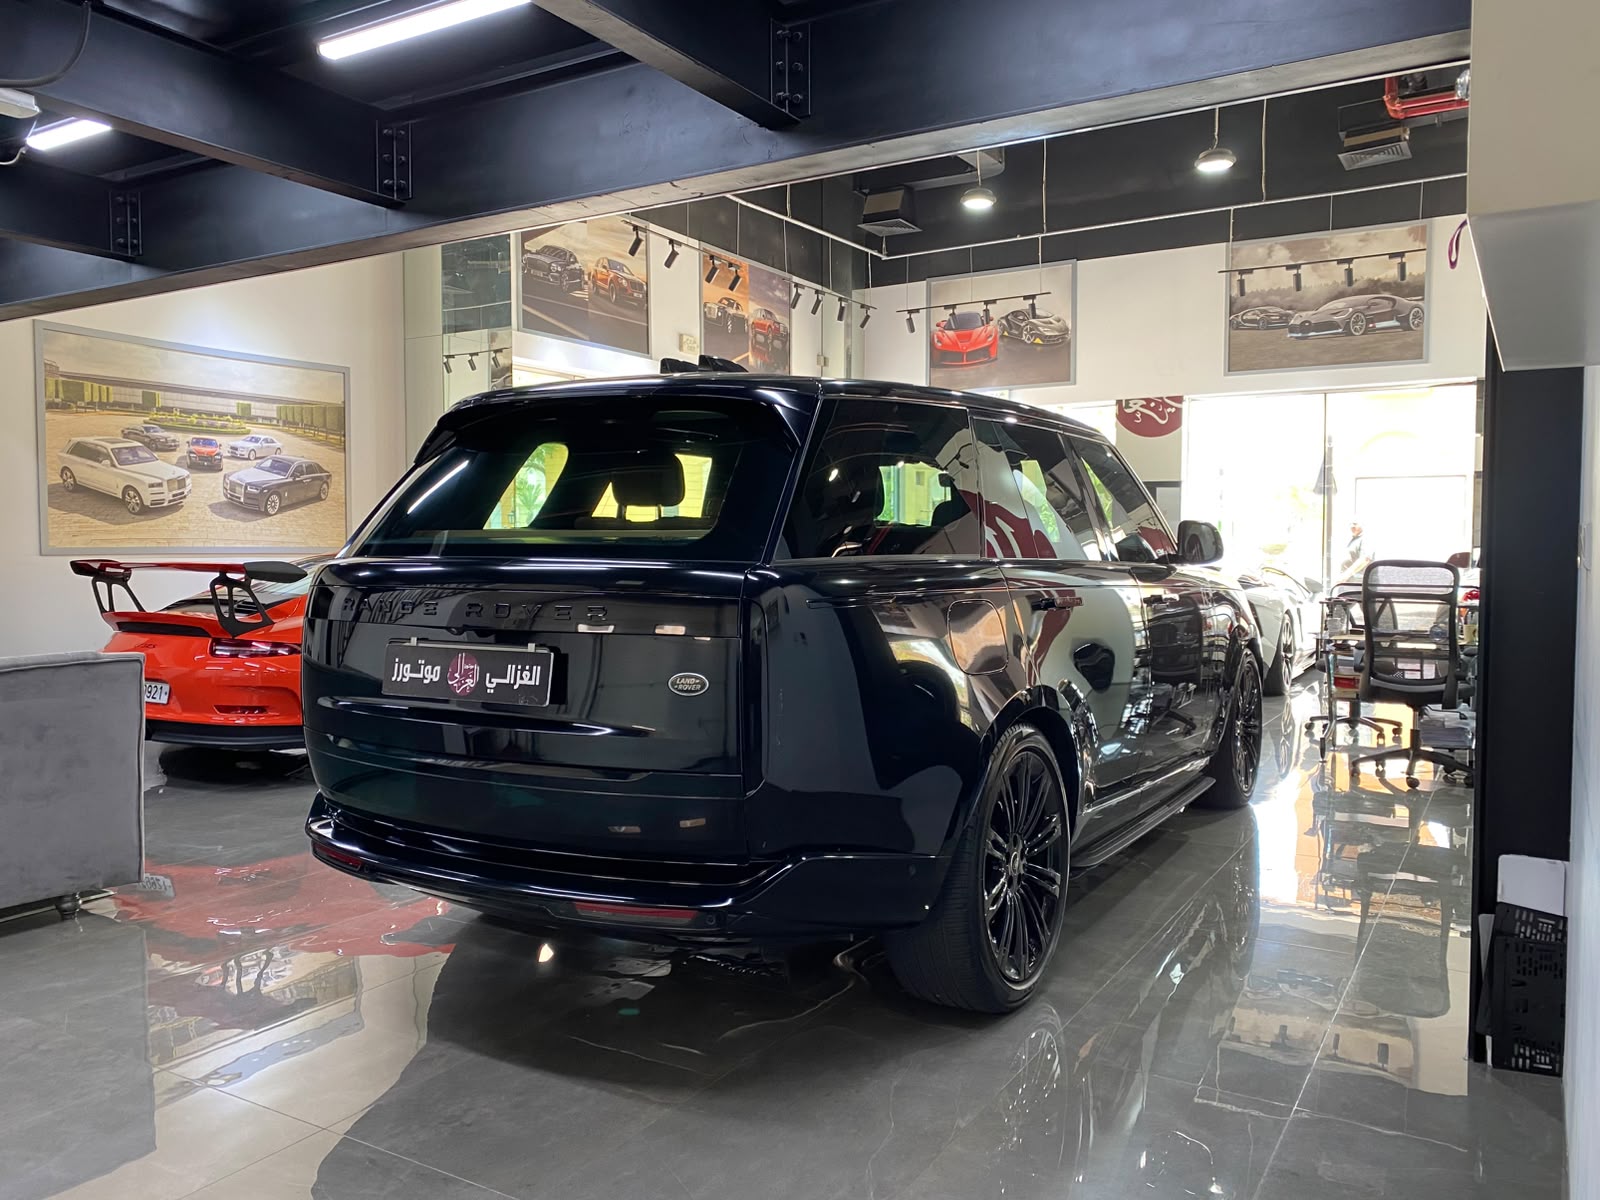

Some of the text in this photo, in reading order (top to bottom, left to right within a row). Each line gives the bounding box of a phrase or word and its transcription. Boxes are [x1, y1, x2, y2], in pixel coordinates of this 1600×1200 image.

[343, 598, 608, 621] RANGE ROVER
[391, 657, 541, 694] الغزالي موتورز
